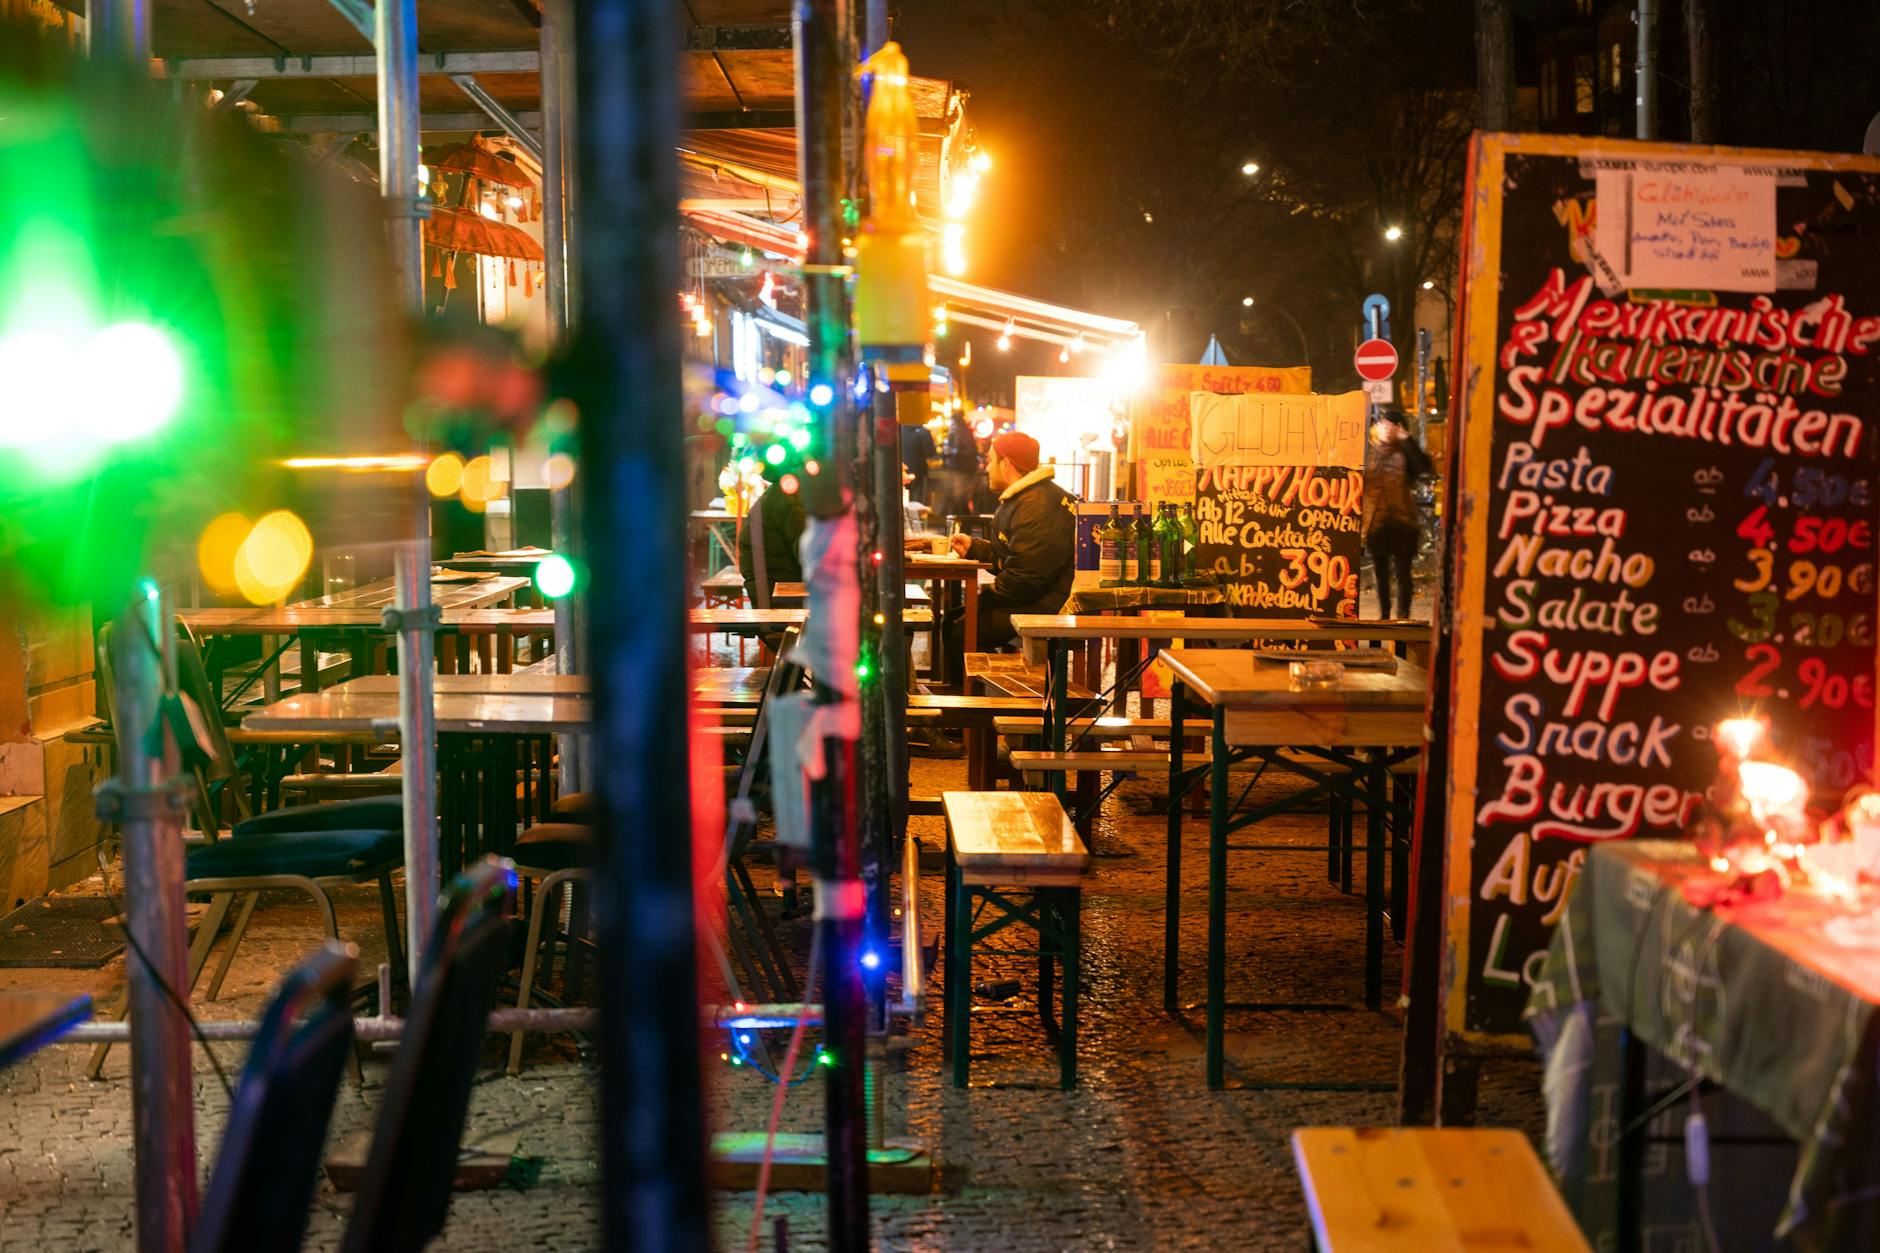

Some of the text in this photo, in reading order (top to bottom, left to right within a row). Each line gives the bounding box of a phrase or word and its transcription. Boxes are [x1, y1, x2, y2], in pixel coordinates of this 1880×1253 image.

[1514, 268, 1880, 354] Mexikanische
[1547, 328, 1848, 397] Italienische
[1498, 364, 1864, 460] Spezialitäten
[1498, 441, 1616, 497] Pasta
[1200, 520, 1239, 545] Alle
[1497, 489, 1628, 539] Pizza
[1686, 504, 1716, 523] ab
[1493, 534, 1656, 588] Nacho
[1687, 547, 1716, 564] ab
[1497, 578, 1662, 636] Salate
[1683, 593, 1715, 615] ab
[1490, 629, 1681, 723] Suppe
[1687, 642, 1720, 664] ab
[1496, 692, 1683, 769] Snack
[1477, 754, 1703, 844] Burger
